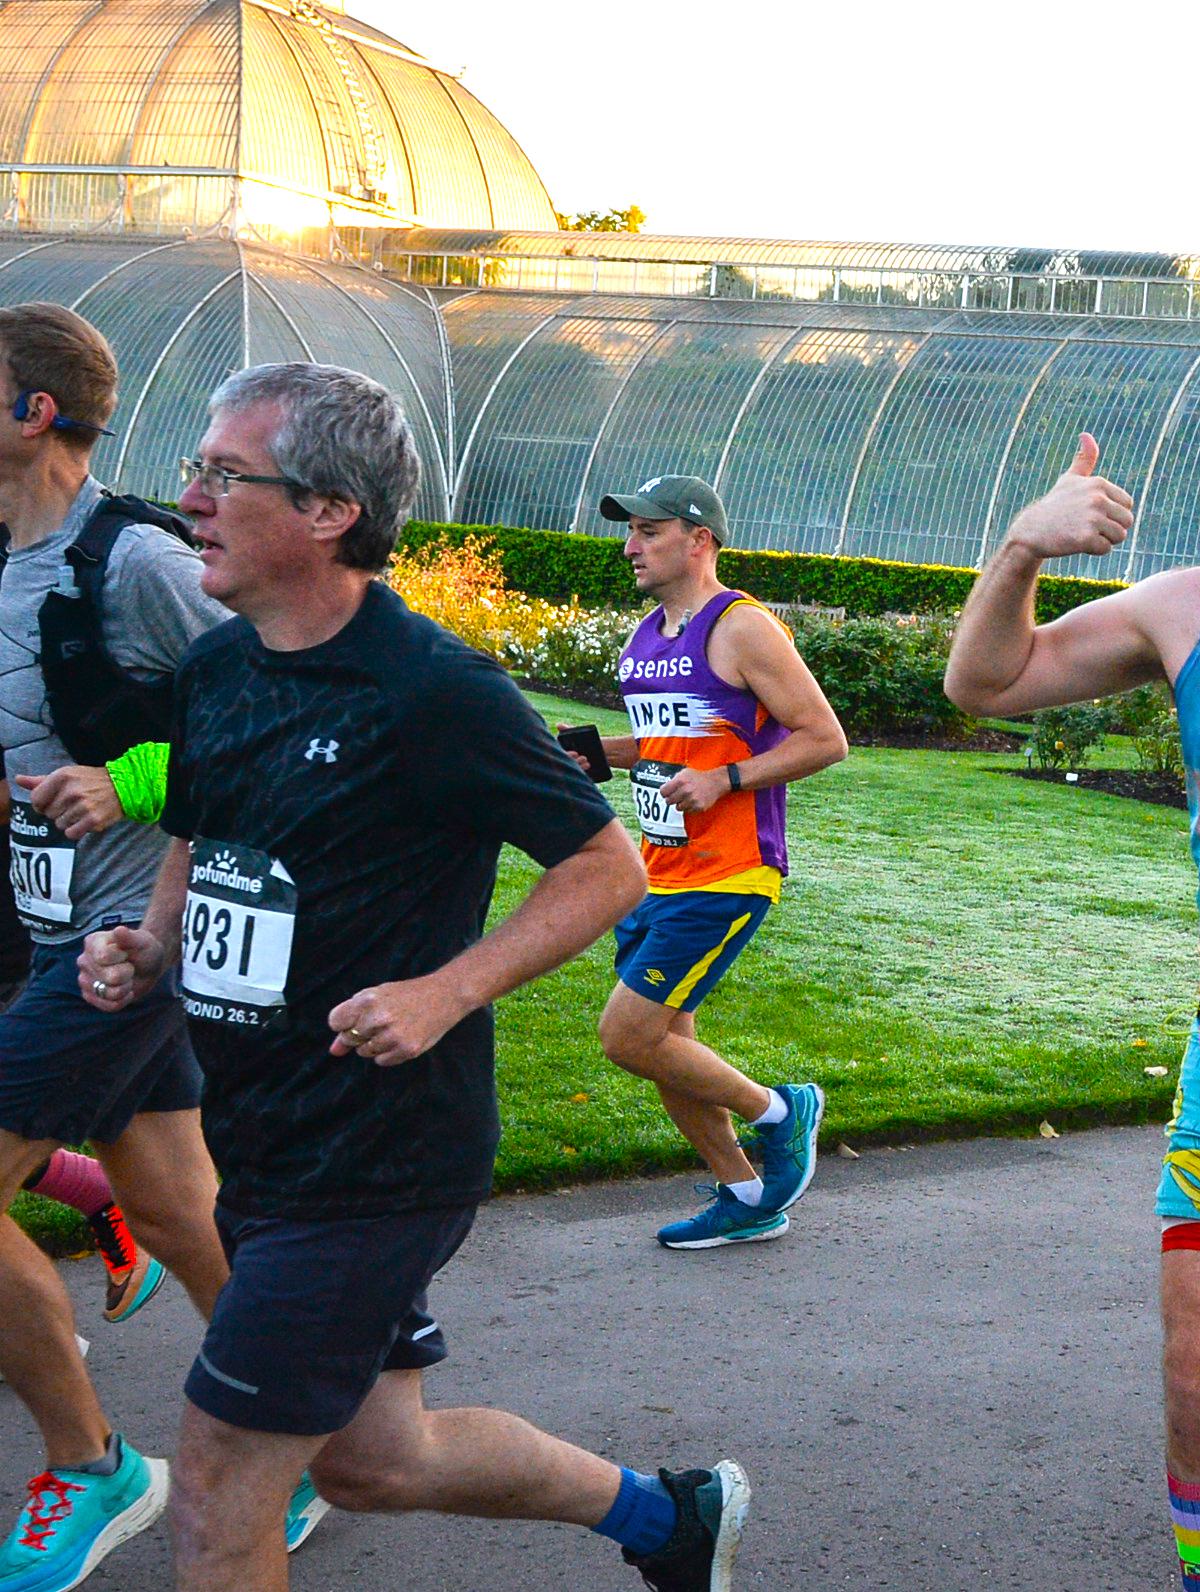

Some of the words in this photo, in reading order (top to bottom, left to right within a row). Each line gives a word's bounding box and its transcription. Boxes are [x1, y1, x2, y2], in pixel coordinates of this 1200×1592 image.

[633, 656, 693, 679] sense
[183, 899, 256, 977] 931
[226, 1007, 260, 1025] 26.2
